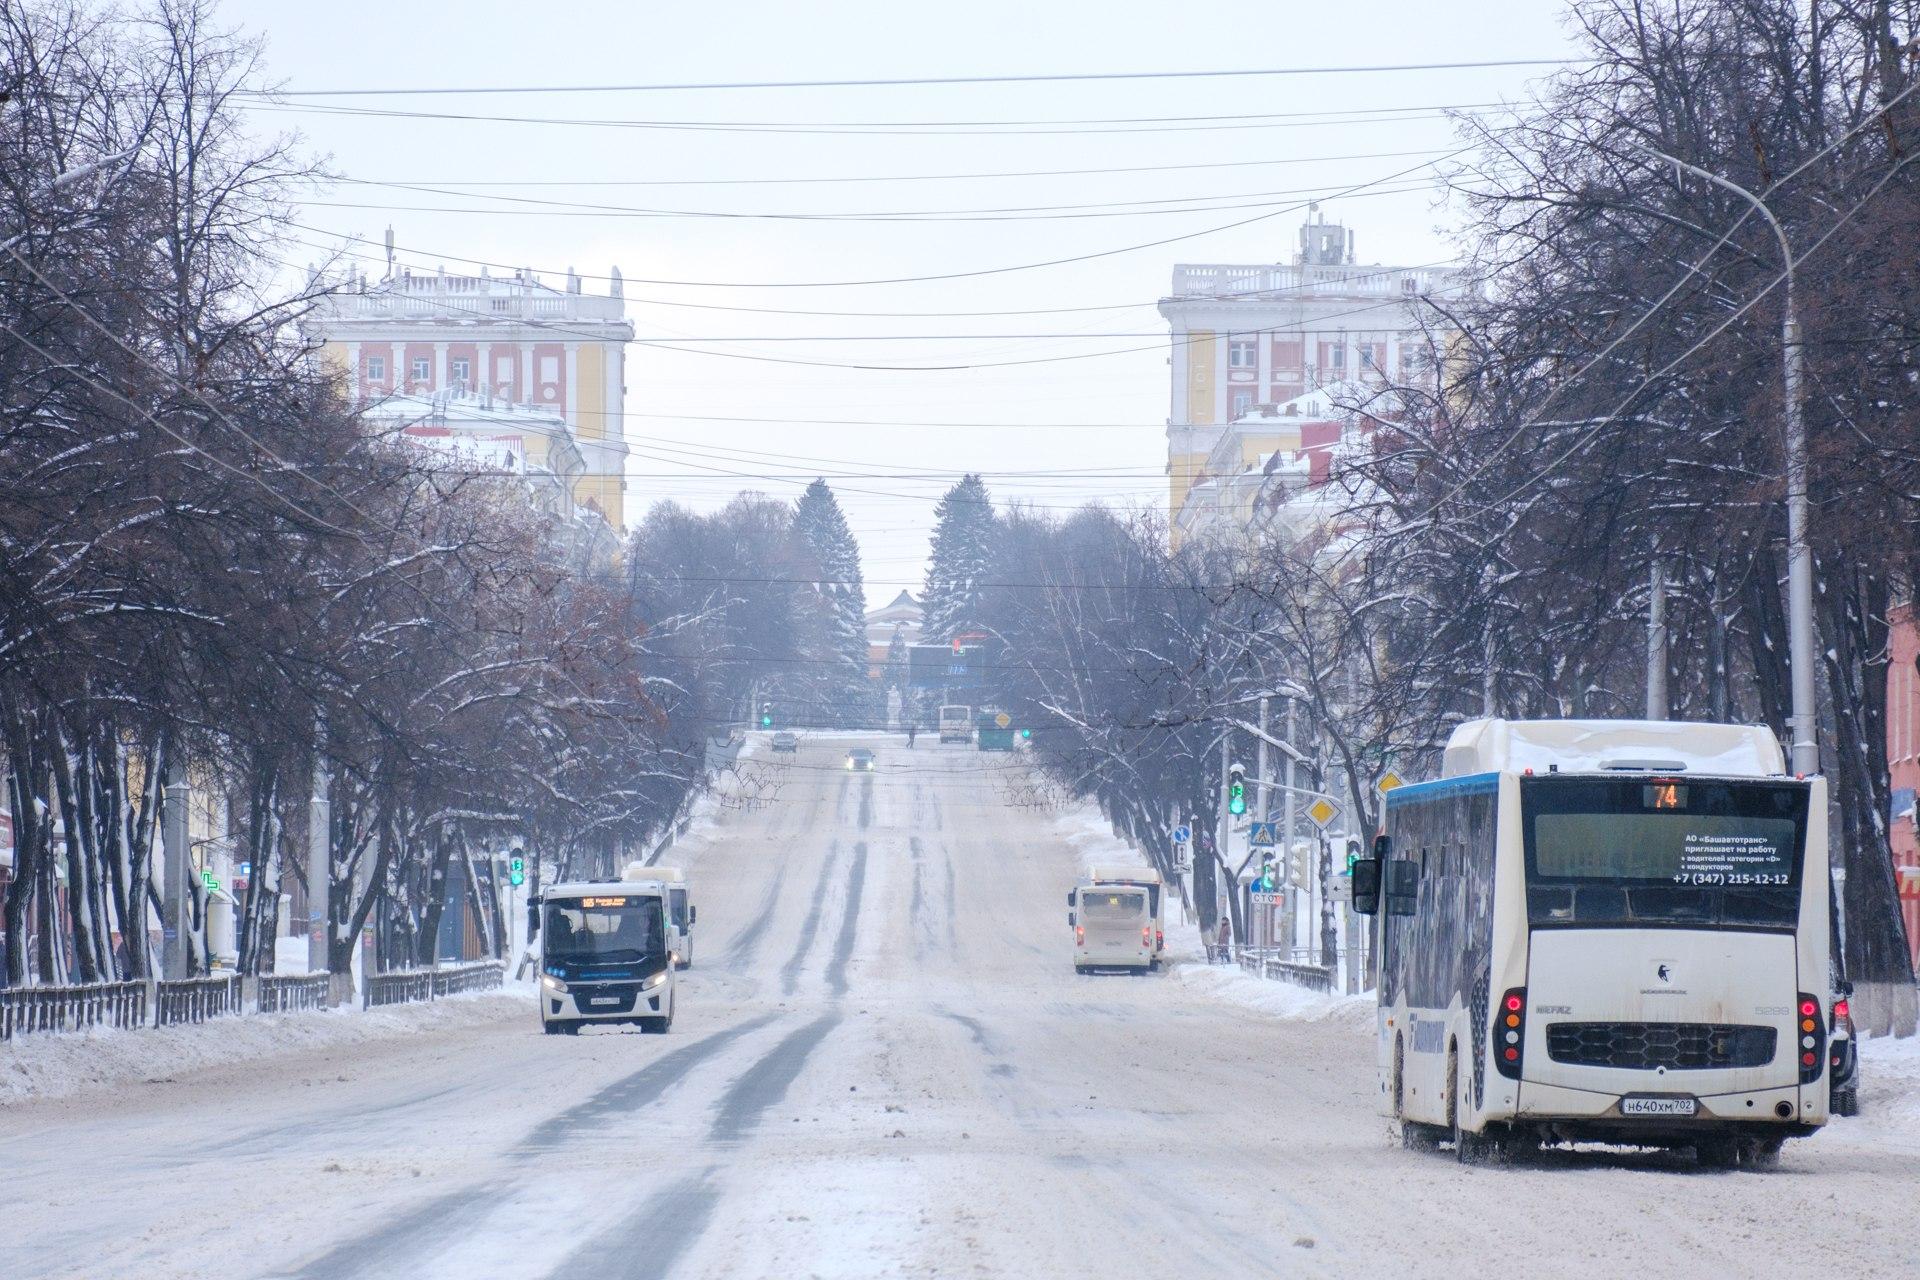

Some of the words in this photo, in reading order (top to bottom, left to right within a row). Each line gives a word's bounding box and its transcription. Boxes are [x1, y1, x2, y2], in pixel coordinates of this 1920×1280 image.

[1654, 784, 1677, 808] 74
[1699, 836, 1768, 844] «Башавтотранс»
[1748, 846, 1777, 854] работу
[1673, 874, 1690, 884] +7
[1692, 873, 1725, 885] (347)
[1728, 873, 1788, 884] 215-12-12
[1674, 1100, 1692, 1109] 702
